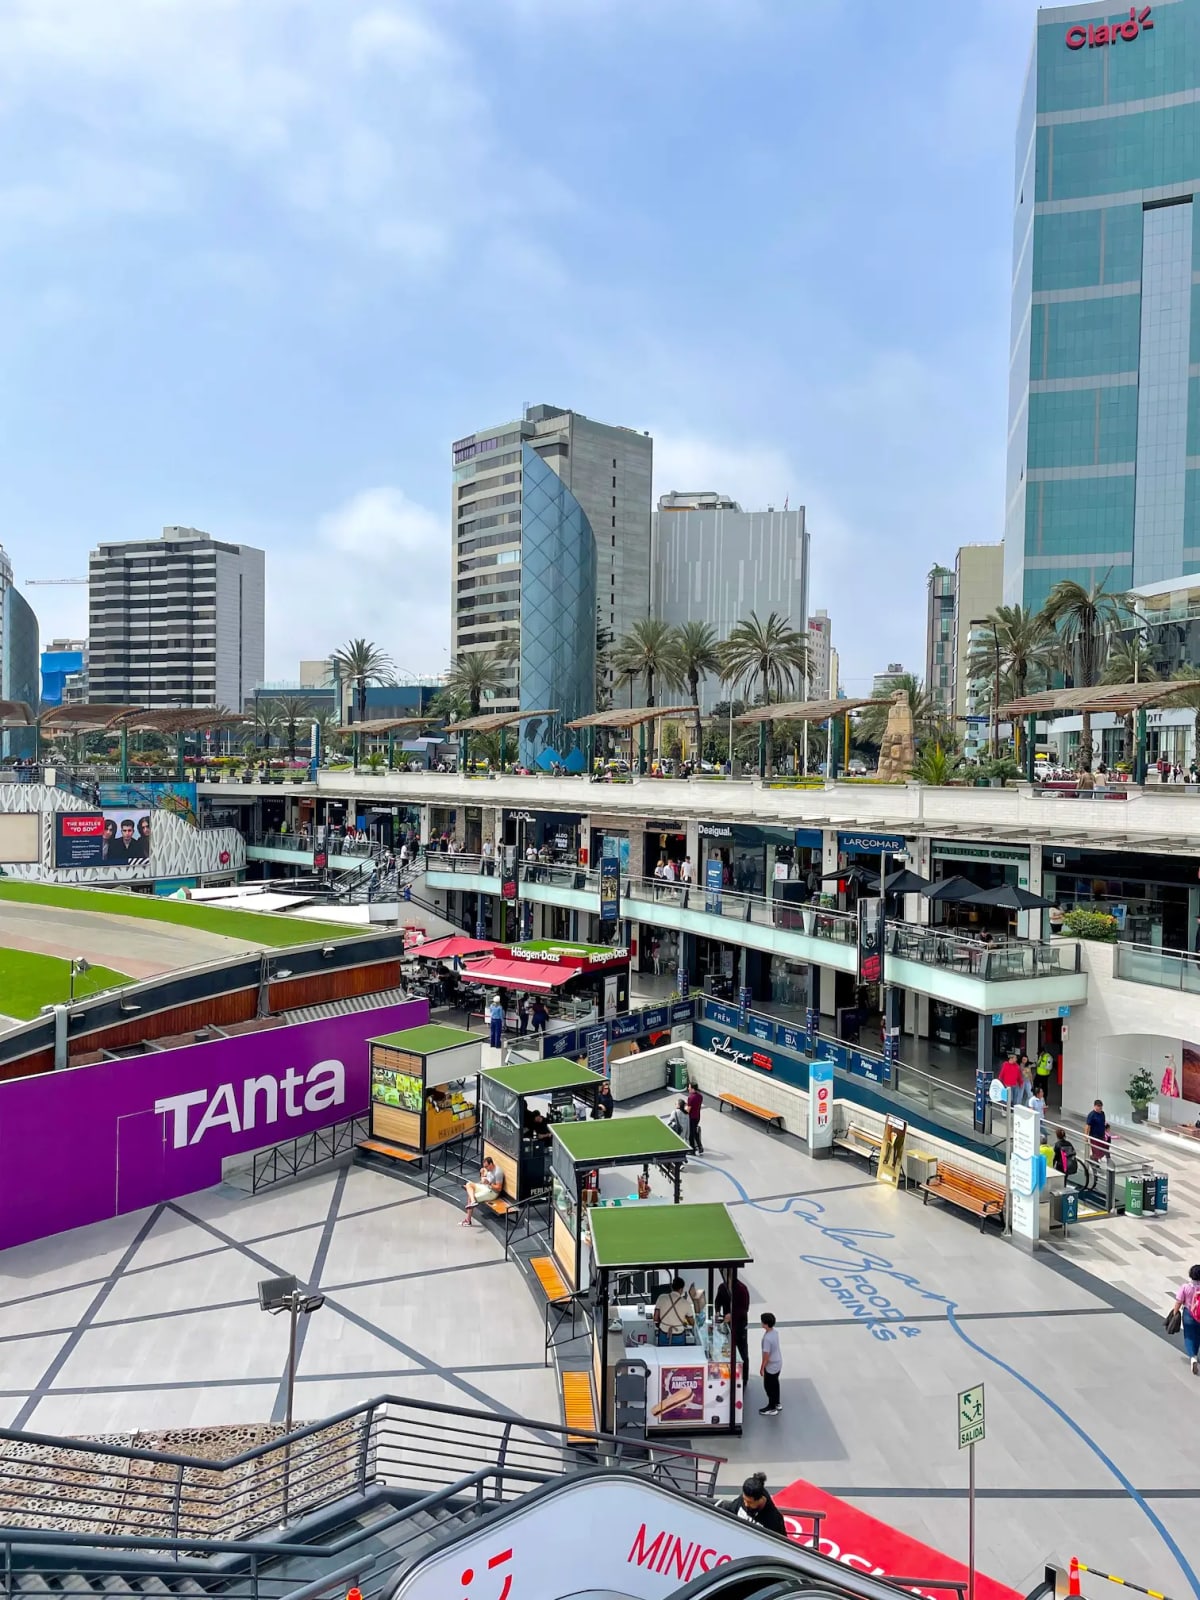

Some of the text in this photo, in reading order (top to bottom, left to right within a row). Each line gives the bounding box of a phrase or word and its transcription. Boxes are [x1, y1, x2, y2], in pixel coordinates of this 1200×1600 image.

[1065, 21, 1139, 50] Claro
[509, 811, 530, 819] ALDO
[843, 838, 900, 850] LARCOMAR
[818, 1277, 897, 1342] DRINKS
[844, 1274, 922, 1338] FOOD &
[961, 1425, 984, 1445] SALIDA
